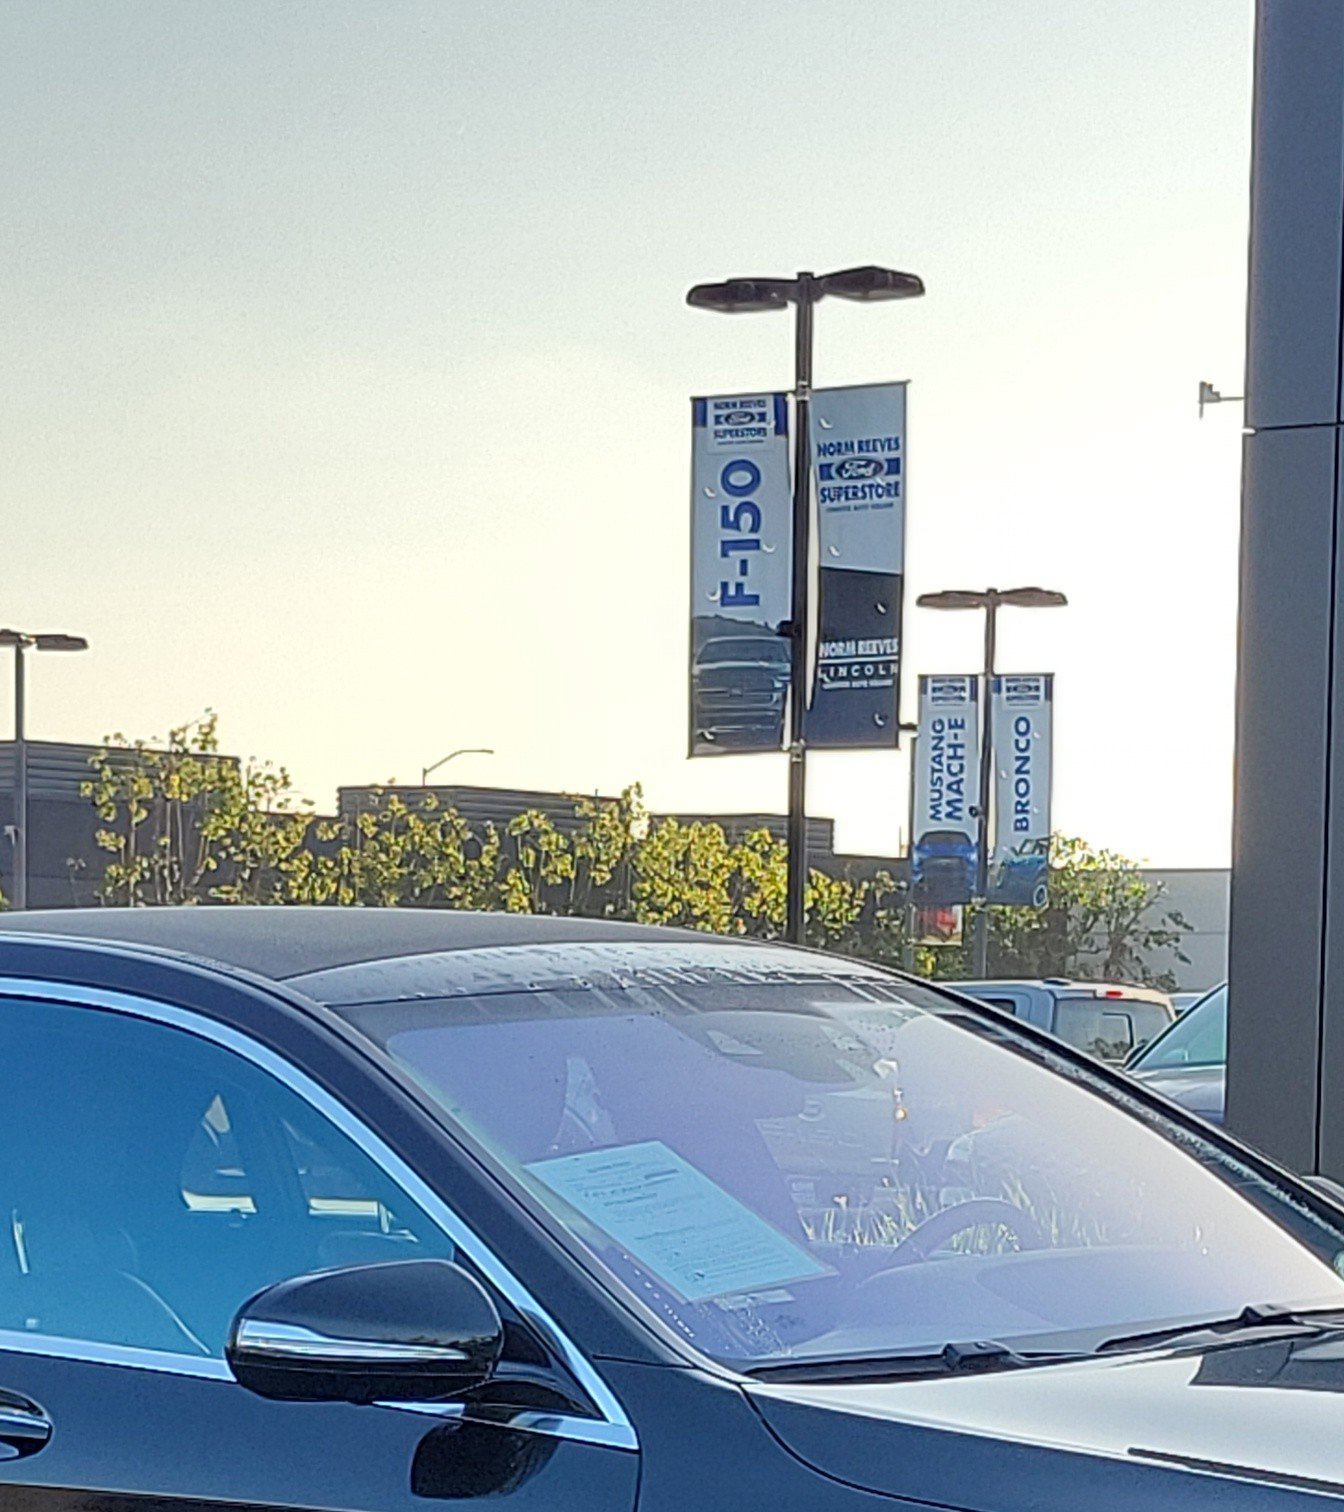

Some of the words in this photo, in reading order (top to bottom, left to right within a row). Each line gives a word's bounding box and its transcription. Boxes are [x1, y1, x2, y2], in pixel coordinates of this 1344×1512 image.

[721, 459, 762, 607] F-150
[820, 481, 900, 504] SUPERSTORE
[929, 718, 945, 822] MUSTANG
[945, 717, 966, 822] MACH-E
[1013, 716, 1031, 832] BRONCO
